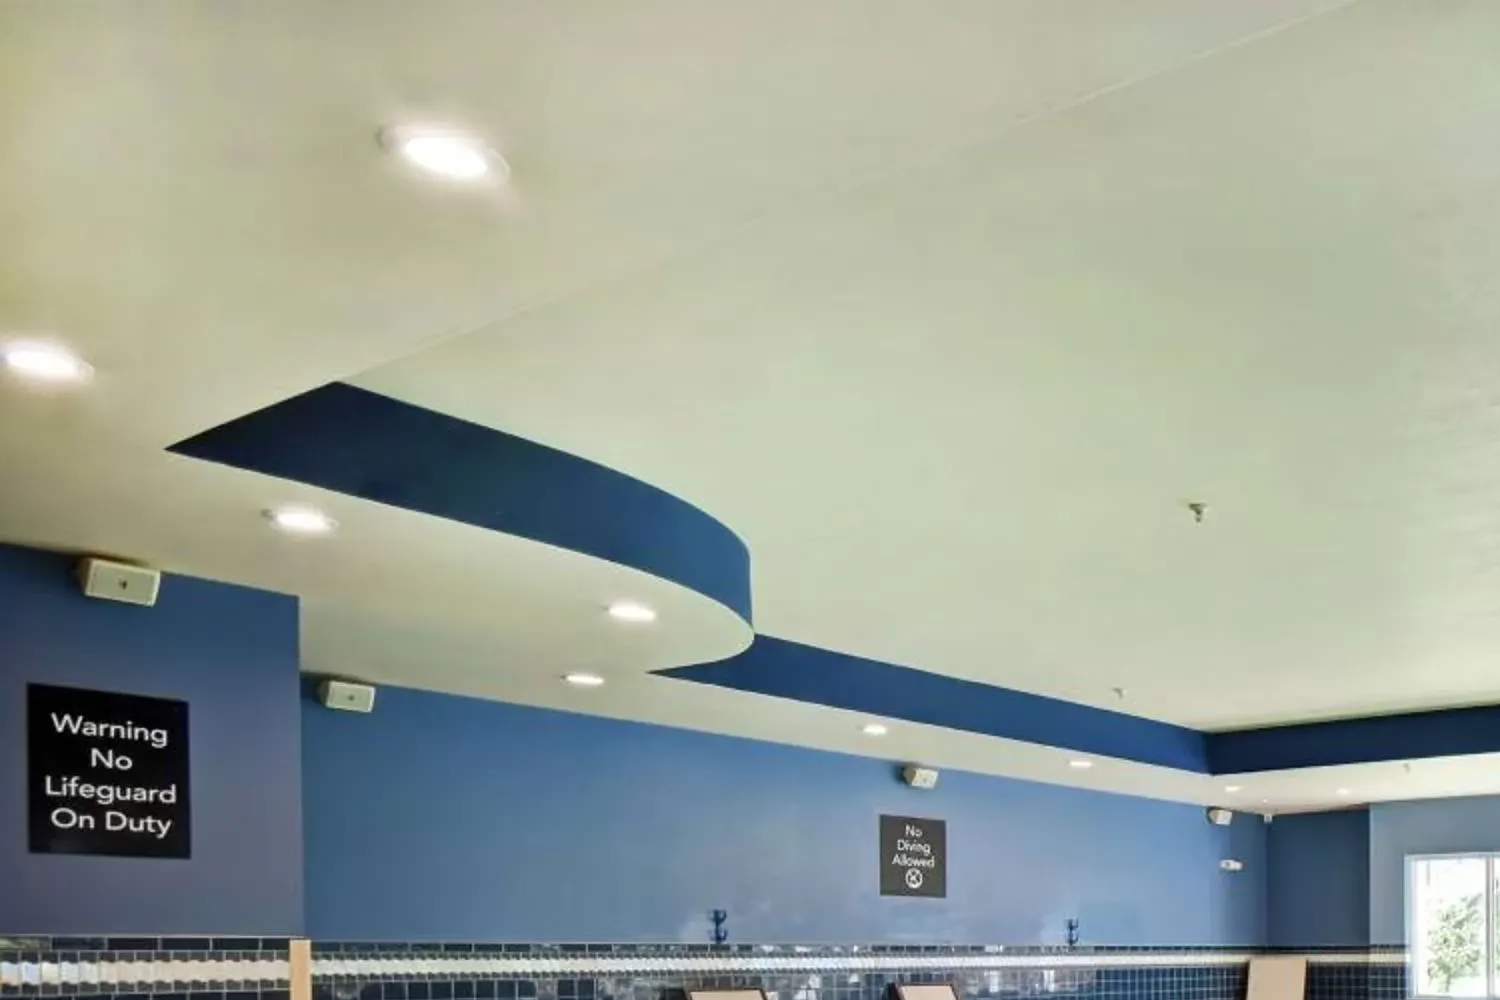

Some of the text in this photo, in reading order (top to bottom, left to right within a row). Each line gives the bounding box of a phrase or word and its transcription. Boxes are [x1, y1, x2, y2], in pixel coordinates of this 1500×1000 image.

[51, 711, 168, 748] Warning
[91, 747, 133, 770] No
[45, 775, 176, 804] Lifeguard
[51, 807, 172, 839] On Duty
[905, 824, 923, 837] No
[897, 839, 931, 856] Diving
[891, 854, 935, 868] Allowed
